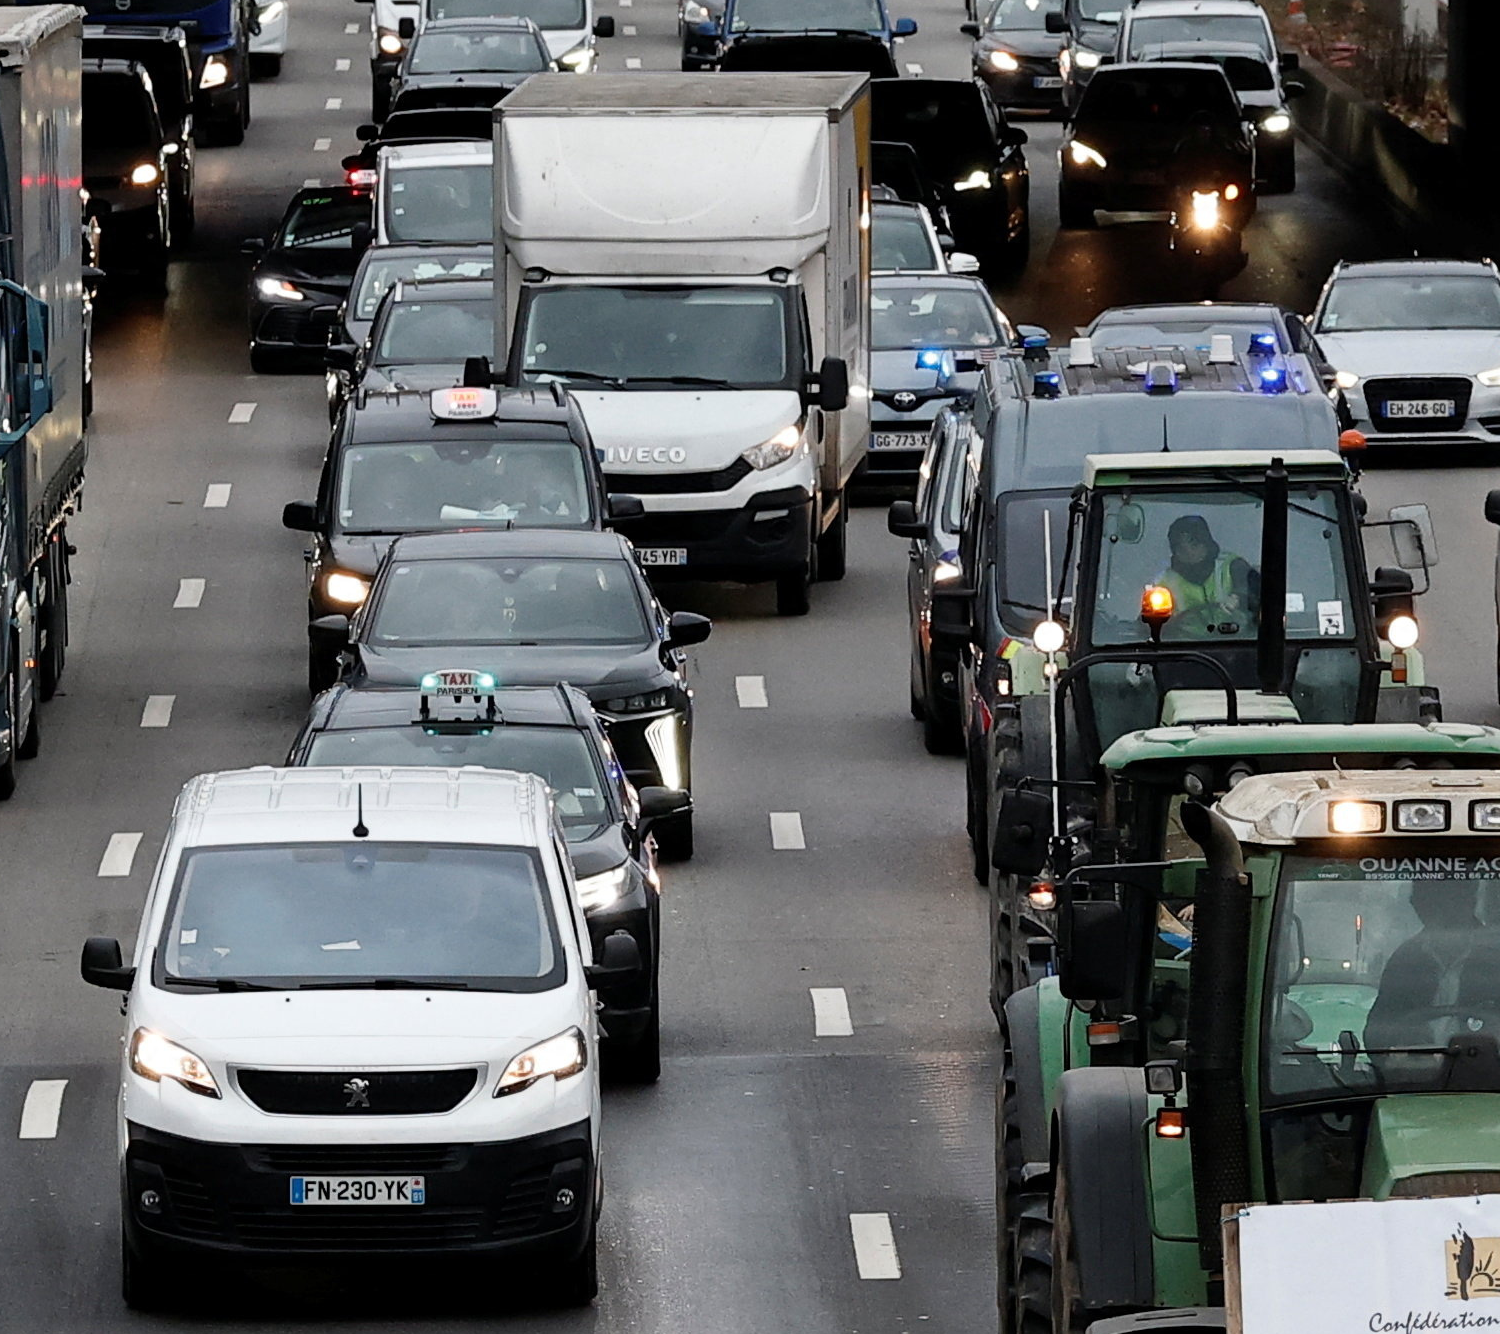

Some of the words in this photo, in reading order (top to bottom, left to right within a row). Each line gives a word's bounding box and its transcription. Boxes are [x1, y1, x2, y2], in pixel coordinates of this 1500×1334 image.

[607, 446, 687, 464] IVECO
[441, 673, 472, 686] TAXI
[437, 687, 478, 695] PARISIEN
[1360, 857, 1467, 872] OUANNE
[304, 1181, 409, 1201] FN-230-YK
